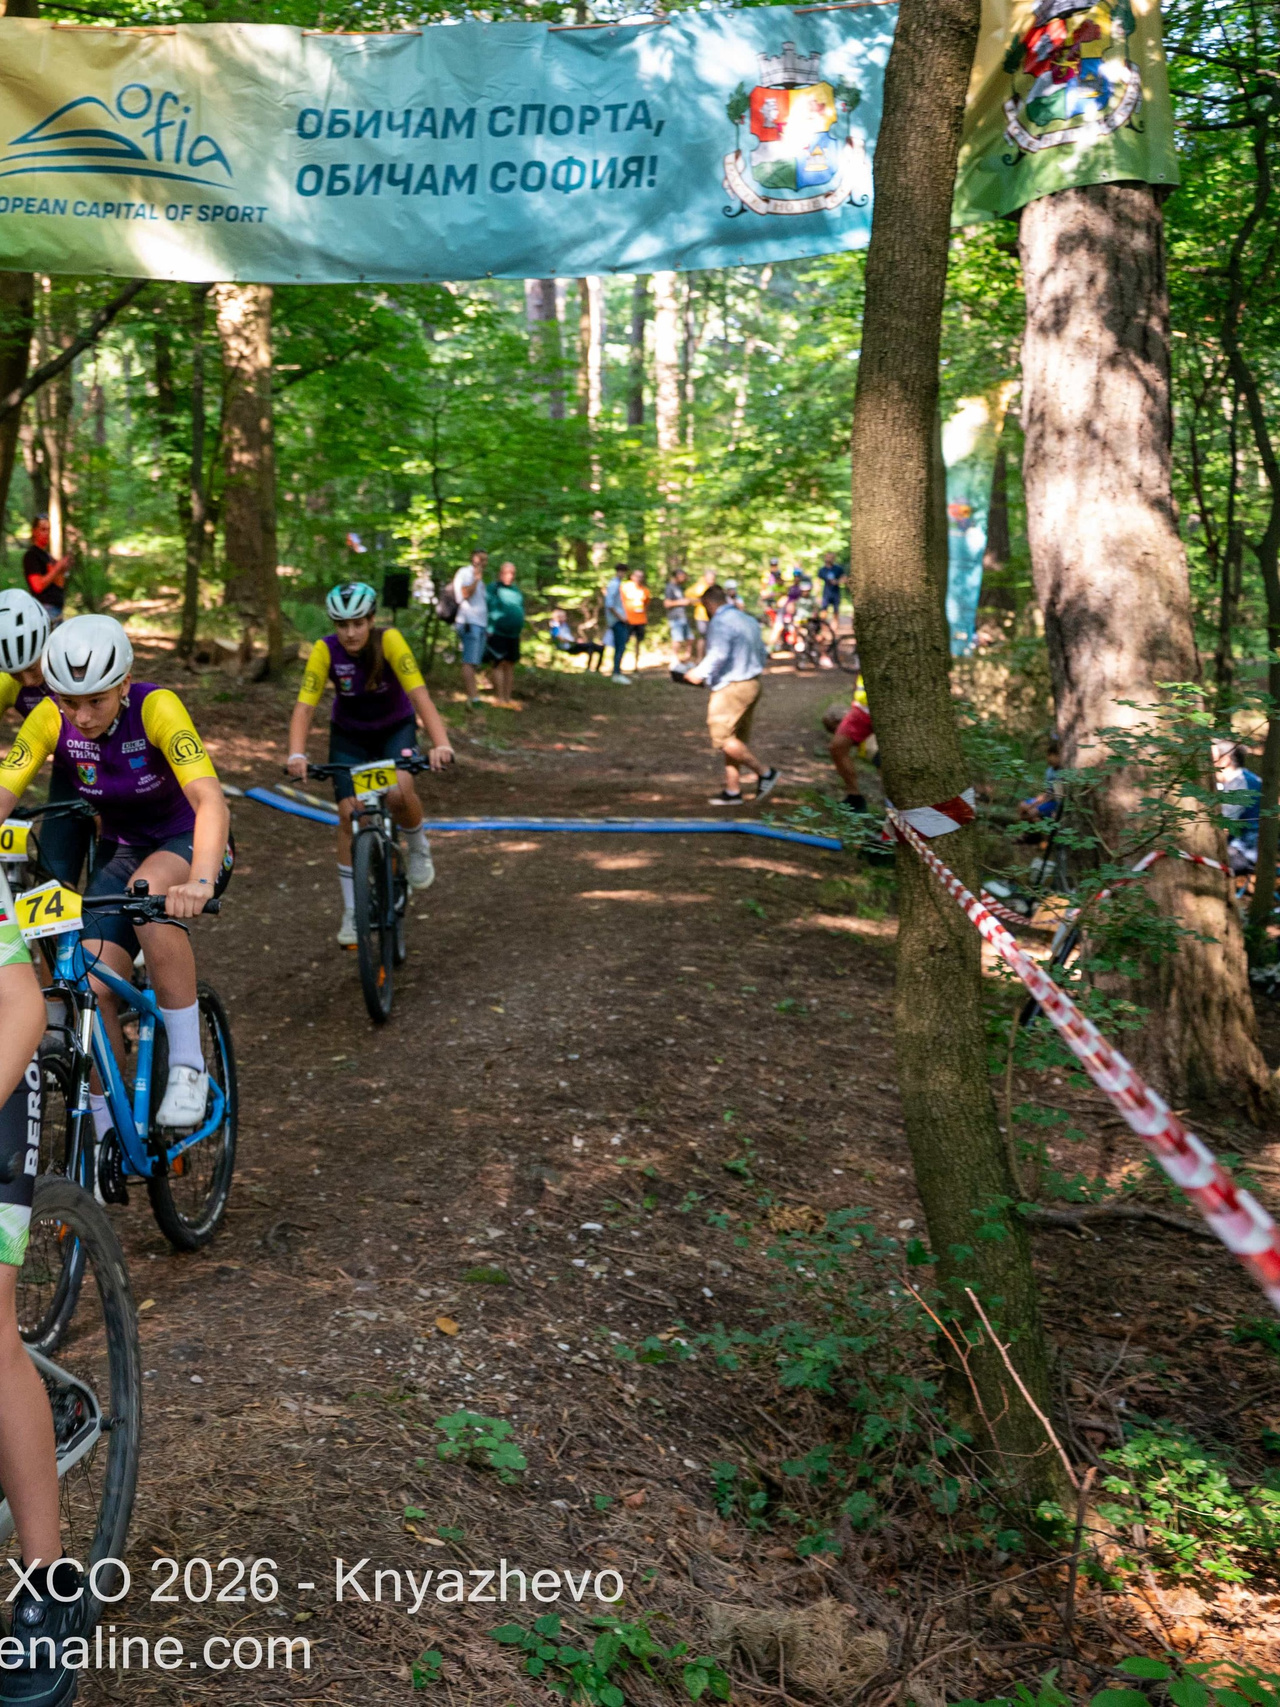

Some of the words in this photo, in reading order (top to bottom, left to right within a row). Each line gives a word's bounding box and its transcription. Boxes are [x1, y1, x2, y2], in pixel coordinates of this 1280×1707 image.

[296, 107, 475, 140] ОБИЧАМ
[487, 99, 668, 138] СПОРТА,
[296, 163, 478, 197] ОБИЧАМ
[488, 155, 658, 195] СОФИЯ!
[73, 200, 160, 221] CAPITAL
[164, 204, 192, 222] OF
[196, 204, 269, 224] SPORT
[361, 770, 389, 790] 76
[26, 890, 64, 924] 74
